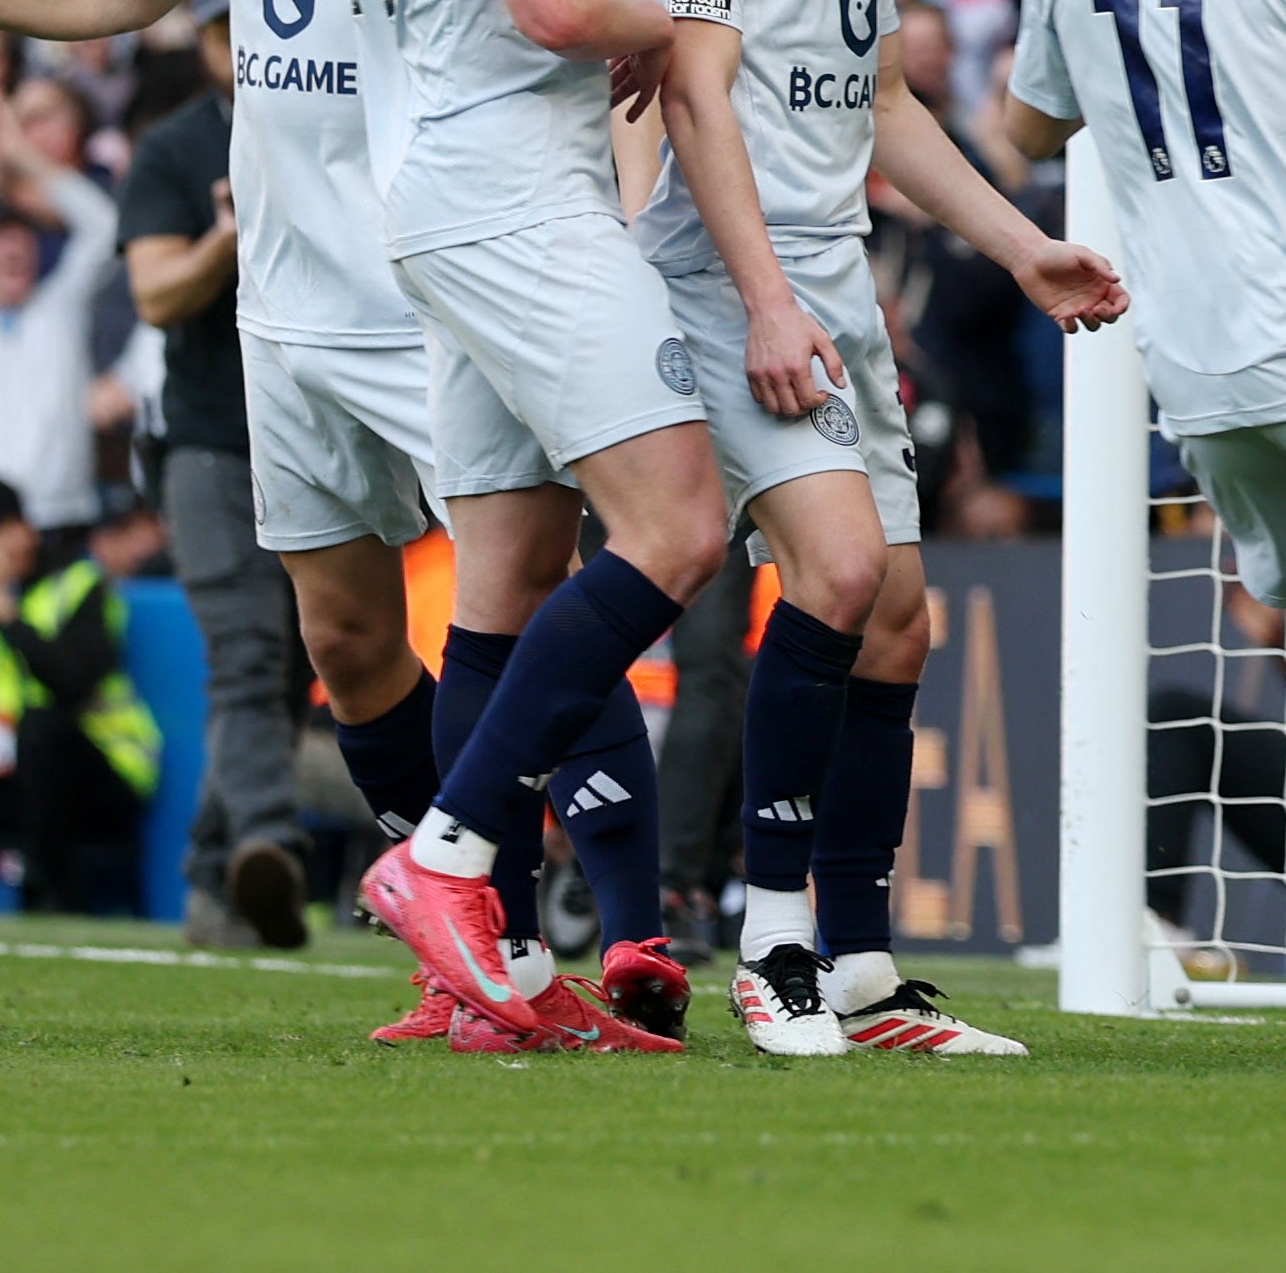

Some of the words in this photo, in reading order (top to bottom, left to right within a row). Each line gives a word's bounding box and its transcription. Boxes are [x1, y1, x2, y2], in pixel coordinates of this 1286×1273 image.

[690, 3, 731, 20] racism
[237, 45, 358, 96] BC.GAME
[789, 66, 877, 112] BC.GA
